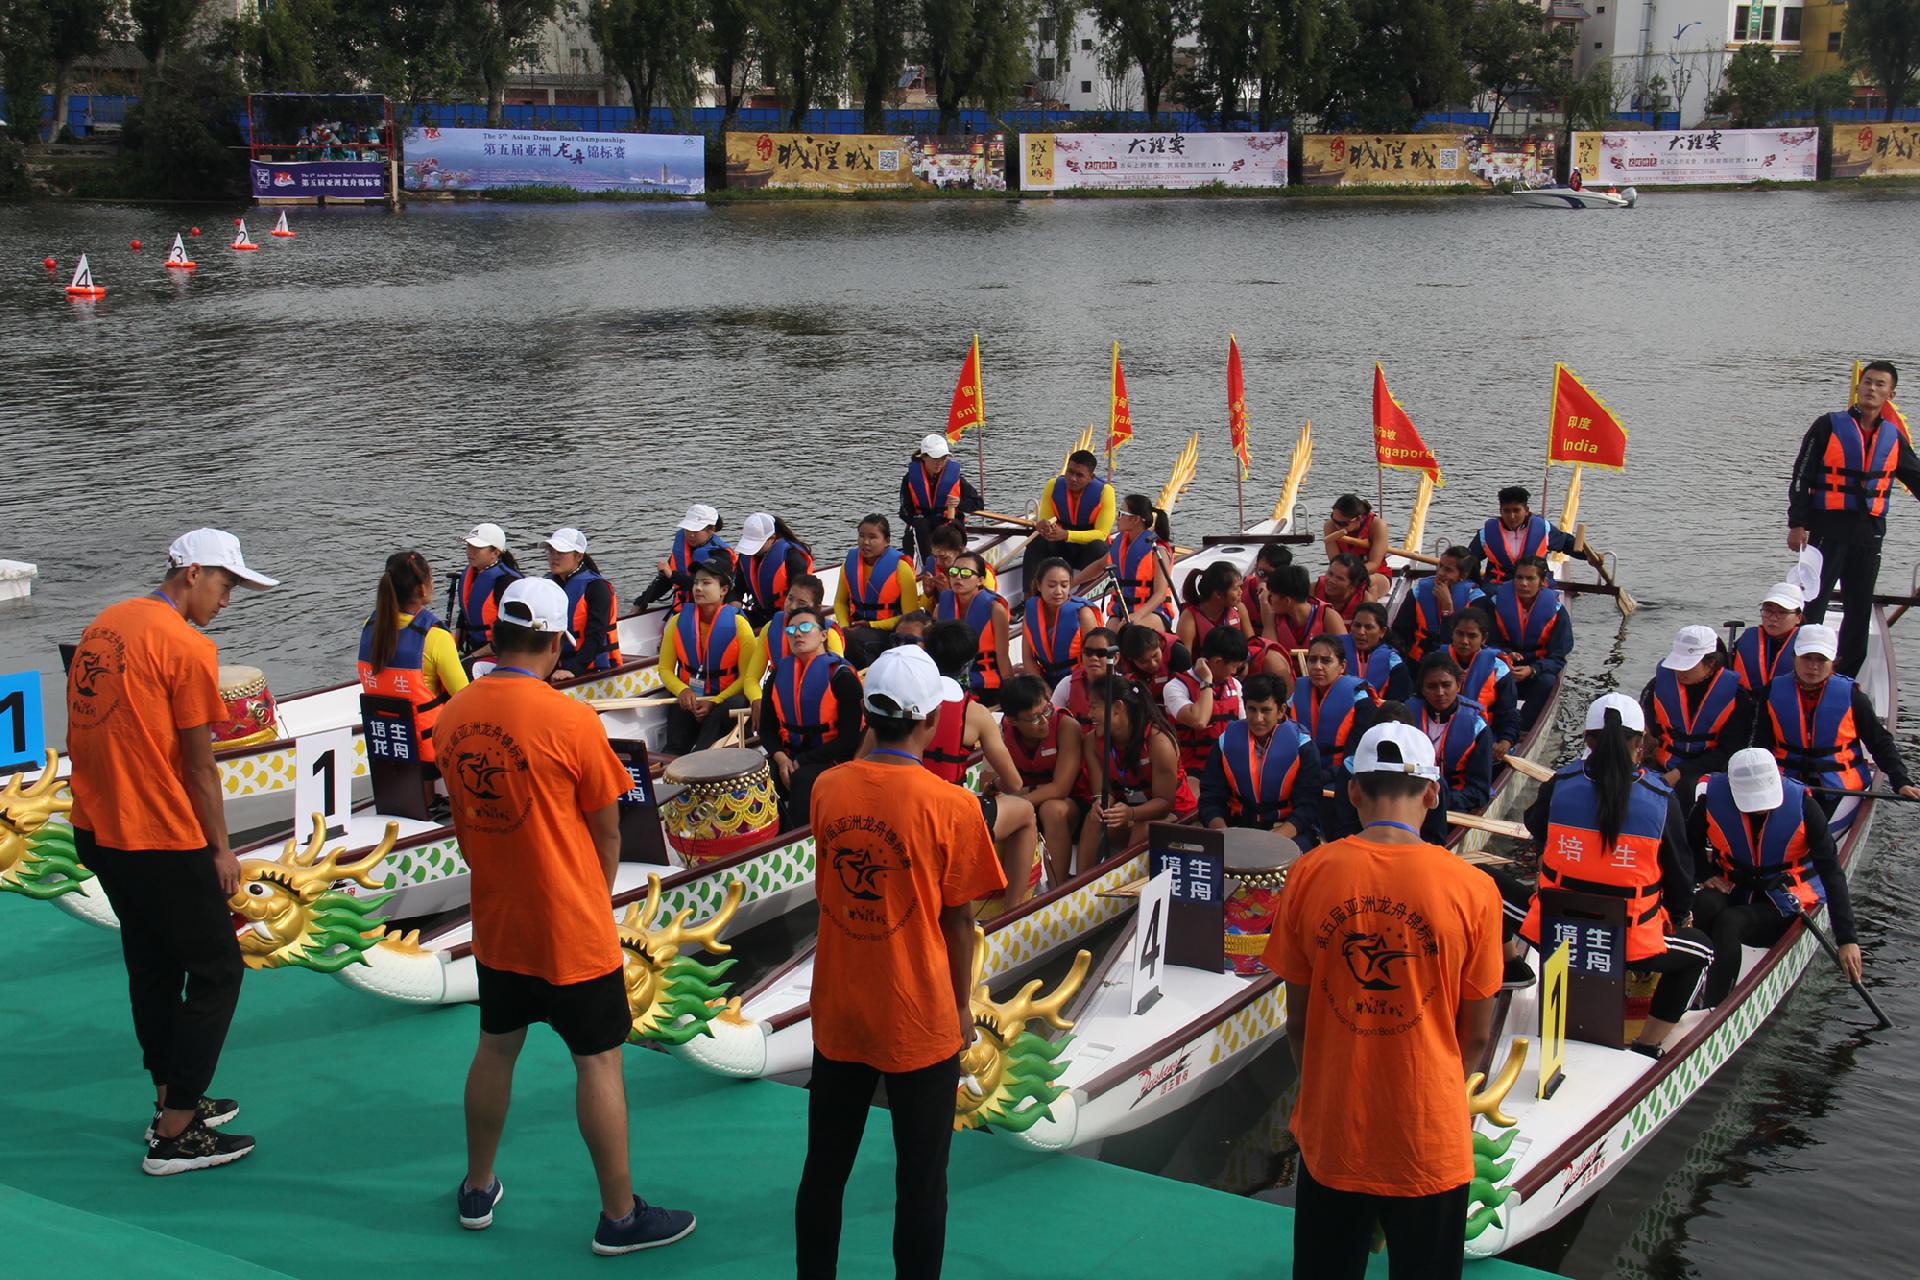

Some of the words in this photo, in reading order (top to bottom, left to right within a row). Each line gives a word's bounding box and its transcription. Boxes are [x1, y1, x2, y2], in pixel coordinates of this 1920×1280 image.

[533, 134, 557, 142] Dragon
[1128, 132, 1185, 155] 大理宴
[1669, 129, 1722, 151] 大理宴
[238, 230, 247, 245] 2
[172, 246, 184, 263] 3
[75, 268, 91, 288] 4
[1567, 415, 1593, 431] 印度
[1563, 438, 1599, 454] India
[0, 690, 26, 754] 1
[370, 720, 407, 742] 培生
[373, 738, 410, 760] 龙舟
[312, 749, 336, 818] 1
[1557, 833, 1637, 869] 培生
[1160, 854, 1212, 880] 培生
[1139, 897, 1161, 980] 4
[1553, 923, 1612, 950] 培生
[1551, 970, 1562, 1061] 1
